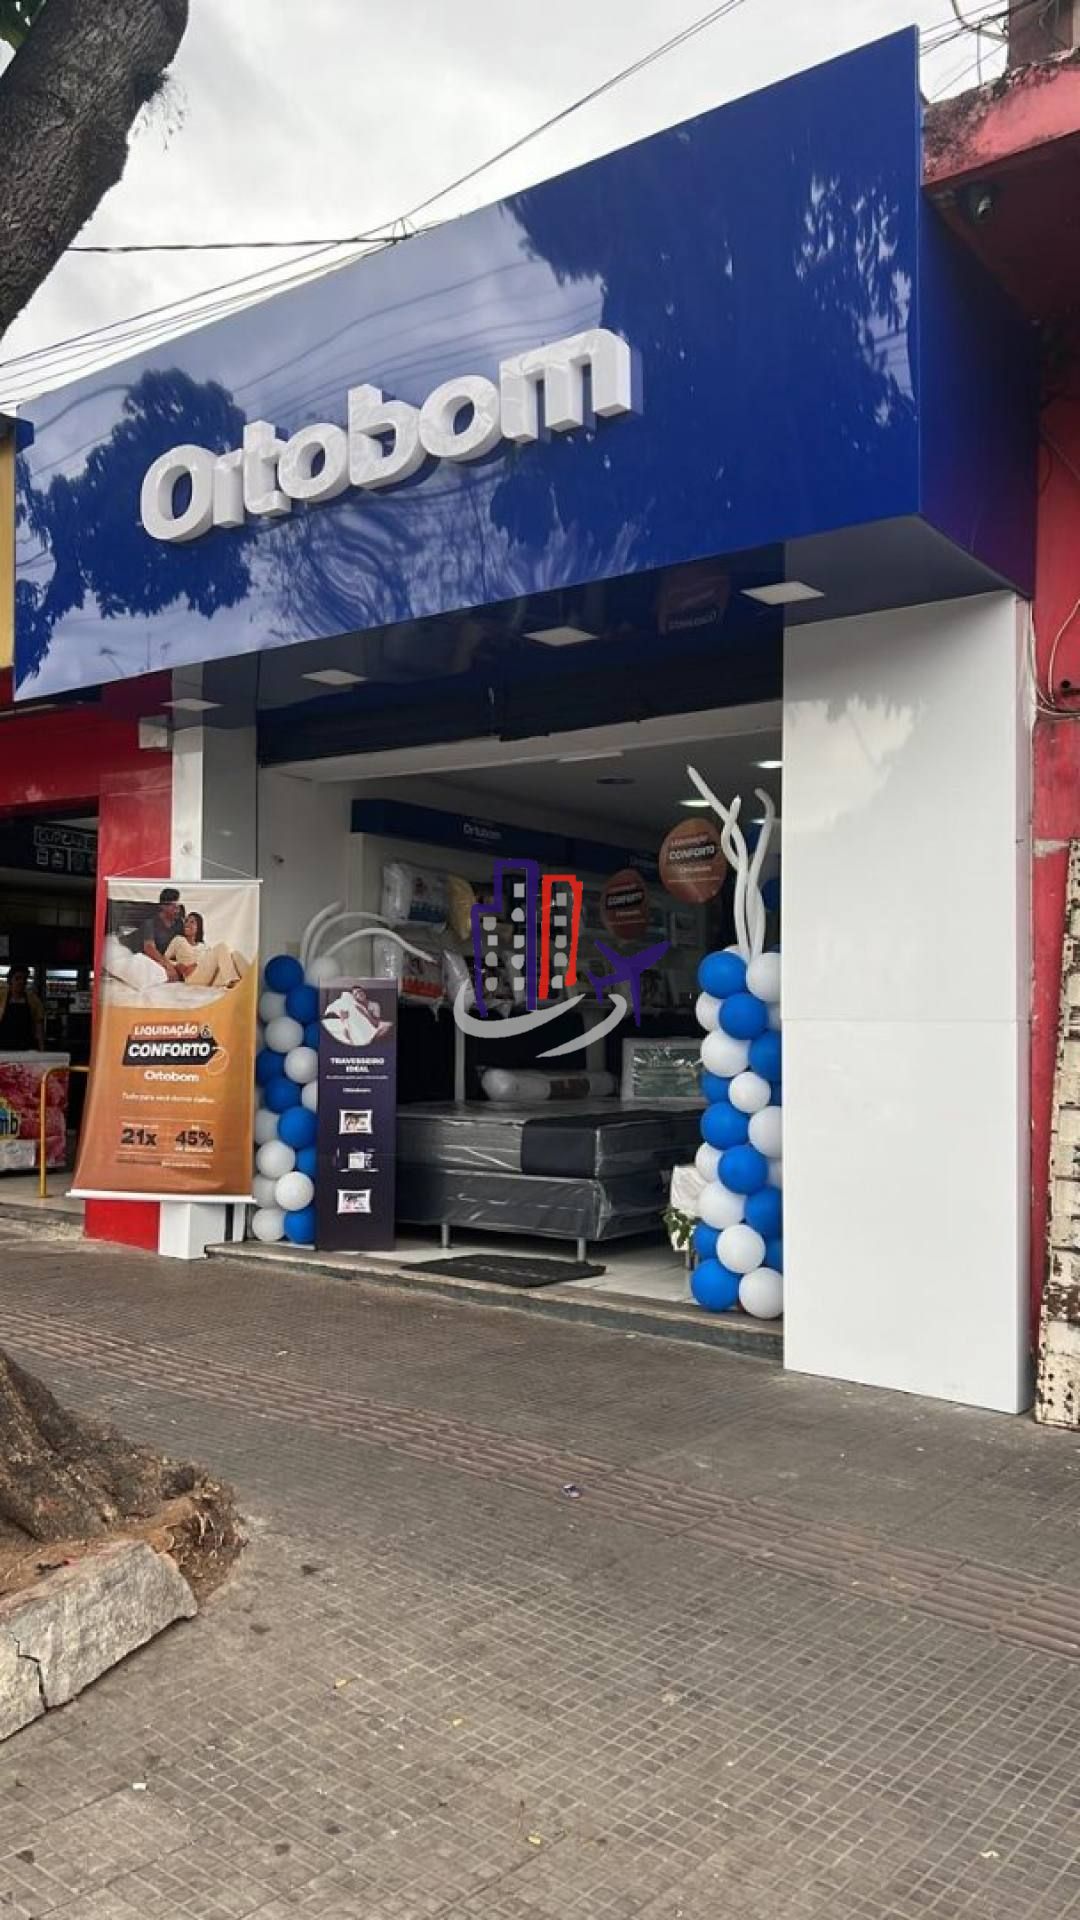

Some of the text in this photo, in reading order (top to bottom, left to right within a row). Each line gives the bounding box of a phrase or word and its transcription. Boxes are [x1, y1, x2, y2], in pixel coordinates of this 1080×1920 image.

[141, 328, 632, 542] Ortobom
[134, 1023, 198, 1038] LIQUIDAÇÃO
[128, 1043, 211, 1057] CONFORTO
[144, 1070, 200, 1082] Ortobom
[120, 1128, 214, 1147] 21x 45%
